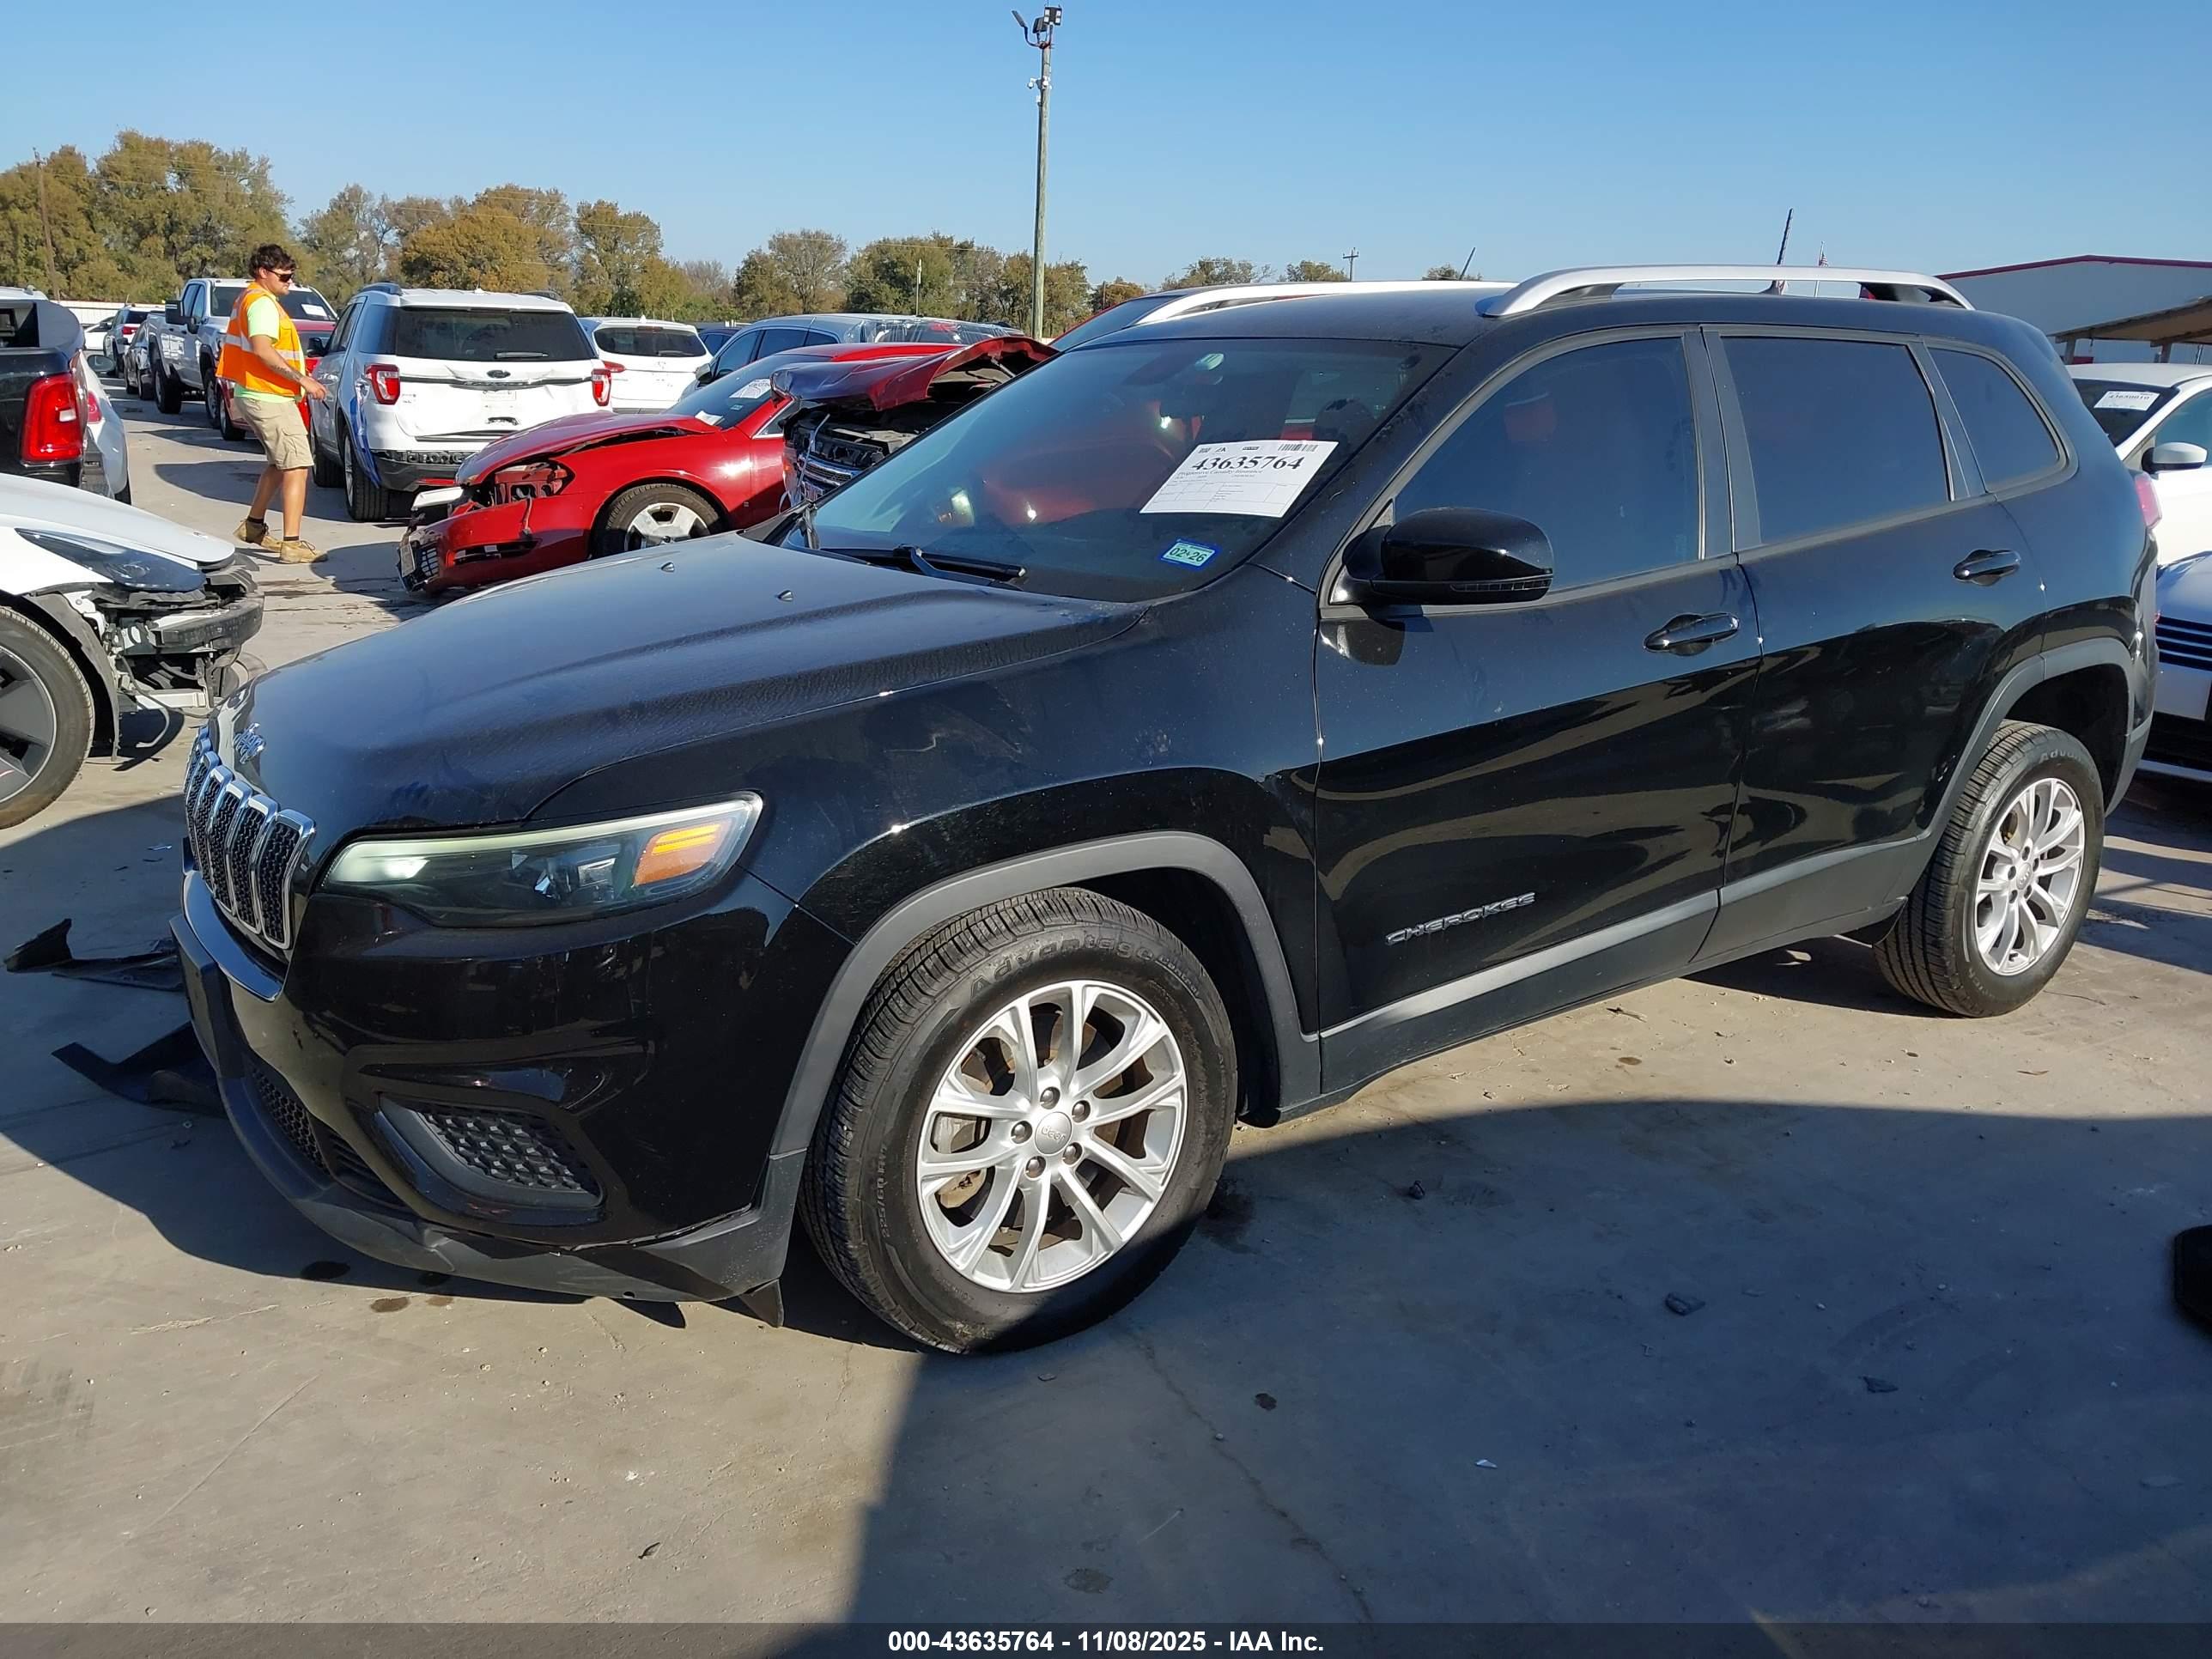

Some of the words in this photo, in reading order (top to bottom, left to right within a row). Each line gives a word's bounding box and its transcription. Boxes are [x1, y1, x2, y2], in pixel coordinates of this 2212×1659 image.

[1192, 455, 1305, 470] 43635764
[1170, 547, 1187, 558] 02
[1188, 551, 1207, 562] 26
[1385, 891, 1535, 945] CHEROKEE
[970, 933, 1154, 1002] Advantage
